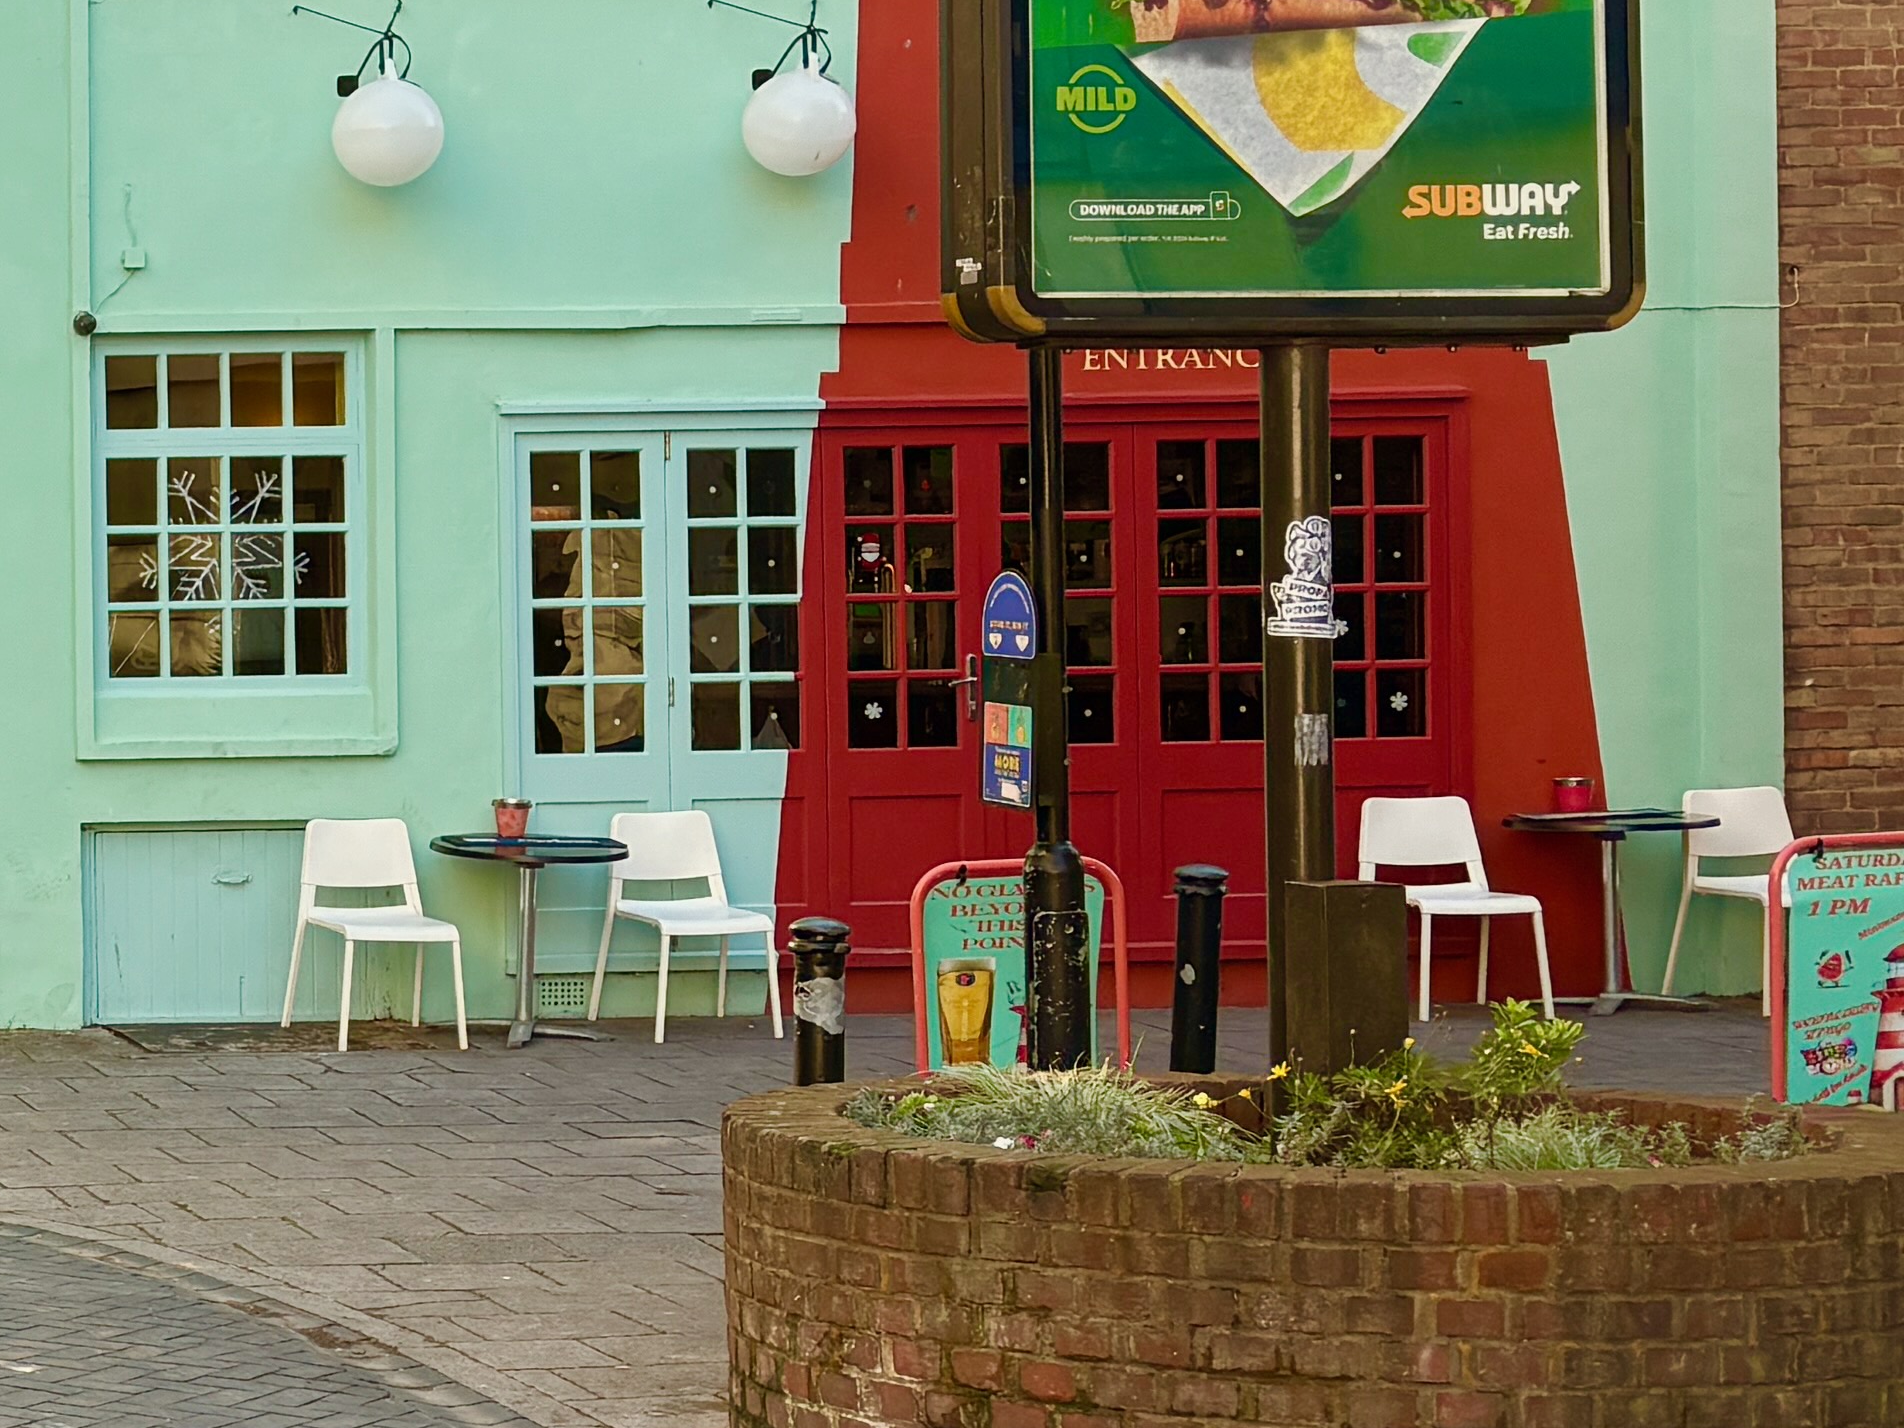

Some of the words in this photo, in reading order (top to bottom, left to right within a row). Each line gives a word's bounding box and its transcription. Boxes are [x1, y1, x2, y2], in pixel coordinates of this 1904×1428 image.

[1056, 86, 1137, 112] MILD
[1401, 180, 1581, 219] SUBWAY
[1079, 204, 1154, 216] DOWNLOAD
[1156, 204, 1179, 215] THE
[1180, 204, 1205, 216] APP
[1483, 223, 1514, 239] Eat
[1518, 222, 1570, 240] Fresh
[1083, 349, 1260, 371] ENTRANC
[1815, 852, 1904, 870] SATURD
[1796, 874, 1859, 891] MEAT
[1864, 872, 1904, 887] RAF
[930, 885, 972, 900] NO
[950, 902, 1024, 917] BEYO
[1808, 899, 1821, 917] 1
[1827, 897, 1872, 916] PM
[961, 936, 1025, 951] POIN
